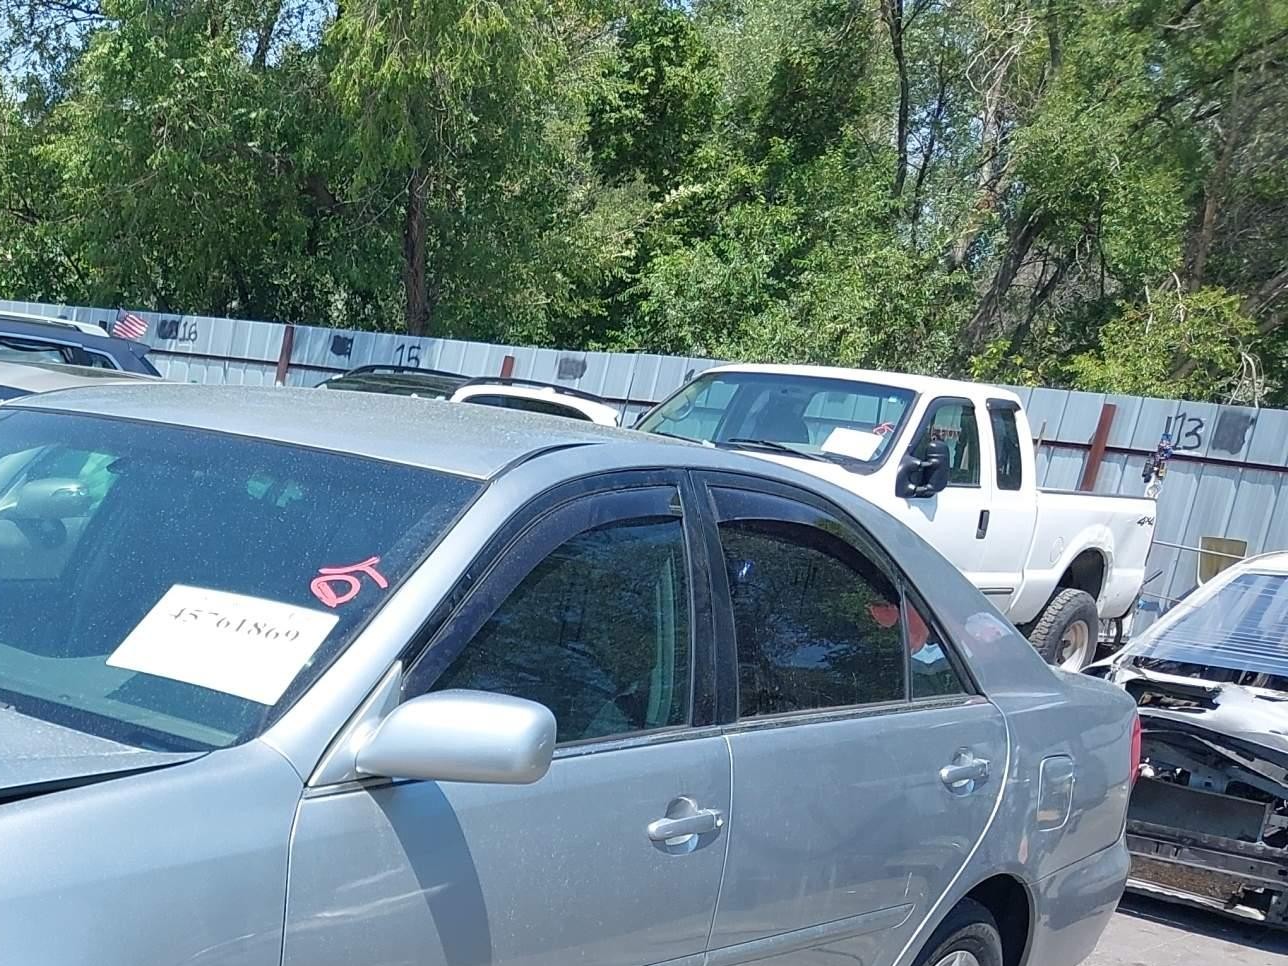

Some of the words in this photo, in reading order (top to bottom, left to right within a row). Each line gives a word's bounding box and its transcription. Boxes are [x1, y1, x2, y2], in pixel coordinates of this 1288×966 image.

[178, 320, 198, 342] 16
[395, 342, 422, 369] 15
[1172, 411, 1205, 451] 13
